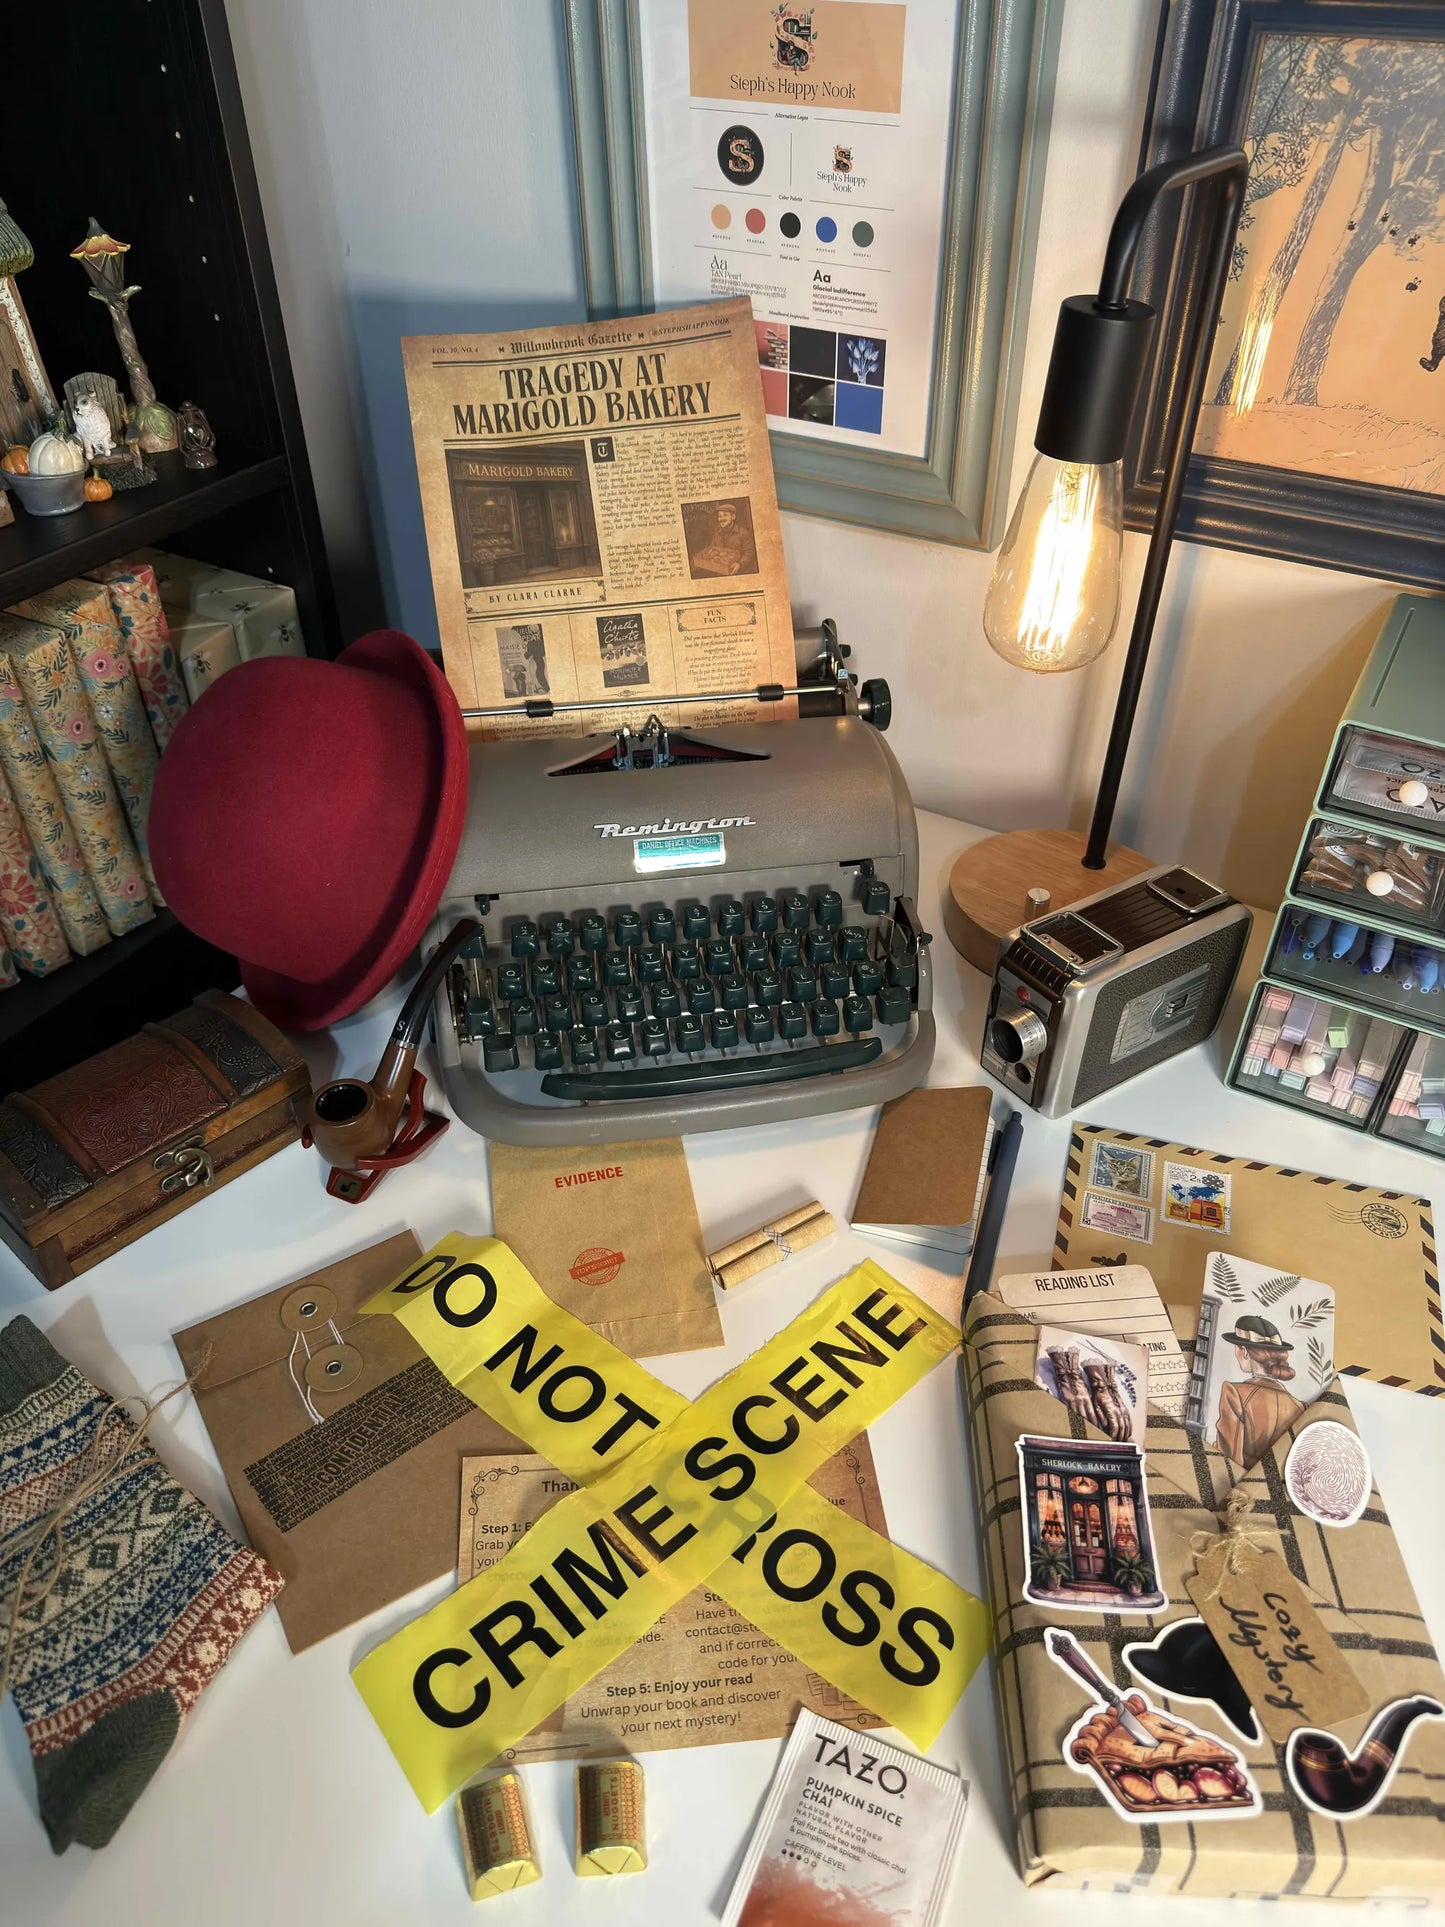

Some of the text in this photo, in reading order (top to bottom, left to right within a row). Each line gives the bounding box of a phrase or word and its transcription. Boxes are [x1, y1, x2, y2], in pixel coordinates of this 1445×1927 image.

[730, 75, 856, 101] Steph's Happy Nook
[817, 171, 867, 188] Steph's Happy
[833, 183, 852, 193] Nook
[710, 255, 728, 271] Aa
[813, 269, 831, 283] Aa
[813, 284, 832, 293] Glacial
[510, 331, 632, 354] Willowbrook Gazette
[499, 353, 667, 400] TRAGEDY AT
[452, 381, 712, 435] MARIGOLD BAKERY
[468, 463, 574, 478] MARIGOLD BAKERY
[489, 595, 501, 604] BY
[507, 591, 538, 602] CLARA
[703, 615, 727, 624] FACTS
[706, 609, 722, 617] FUN
[603, 620, 638, 635] Agatha
[604, 631, 641, 644] Christie
[594, 817, 757, 839] Remington
[642, 841, 663, 850] DANIEL
[686, 837, 718, 848] MACHINES
[554, 1166, 624, 1189] EVIDENCE
[1035, 1274, 1115, 1292] READING LIST
[391, 1253, 498, 1329] DO
[482, 1323, 662, 1457] NOT
[1042, 1458, 1122, 1472] SHERLOCK BAKERY
[541, 1480, 579, 1493] Than
[412, 1484, 699, 1729] CRIME
[683, 1287, 928, 1501] SCENE
[481, 1524, 509, 1535] Step
[511, 1523, 522, 1533] 1:
[475, 1539, 504, 1551] Grab
[696, 1610, 726, 1620] Have
[1263, 1592, 1325, 1675] Cozy
[700, 1642, 722, 1654] and
[725, 1641, 735, 1652] if
[718, 1656, 748, 1670] code
[751, 1655, 768, 1667] for
[1218, 1595, 1313, 1723] Mystery
[606, 1673, 753, 1699] Step 5: Enjoy your read
[580, 1689, 782, 1719] Unwrap your book and discover
[621, 1711, 742, 1737] your next mystery!
[814, 1732, 908, 1795] TAZO
[610, 1776, 619, 1831] NUGGETS
[802, 1788, 833, 1808] CHAI
[806, 1776, 903, 1828] PUMPKIN SPICE
[795, 1809, 868, 1844] NATURAL FLAVOR
[798, 1801, 884, 1843] FLAVOR WITH OTHER
[792, 1817, 908, 1876] Fall for black tea with classic chai
[795, 1827, 827, 1847] pumpkin
[827, 1839, 838, 1852] pie
[784, 1838, 847, 1872] CAFFEINE LEVEL
